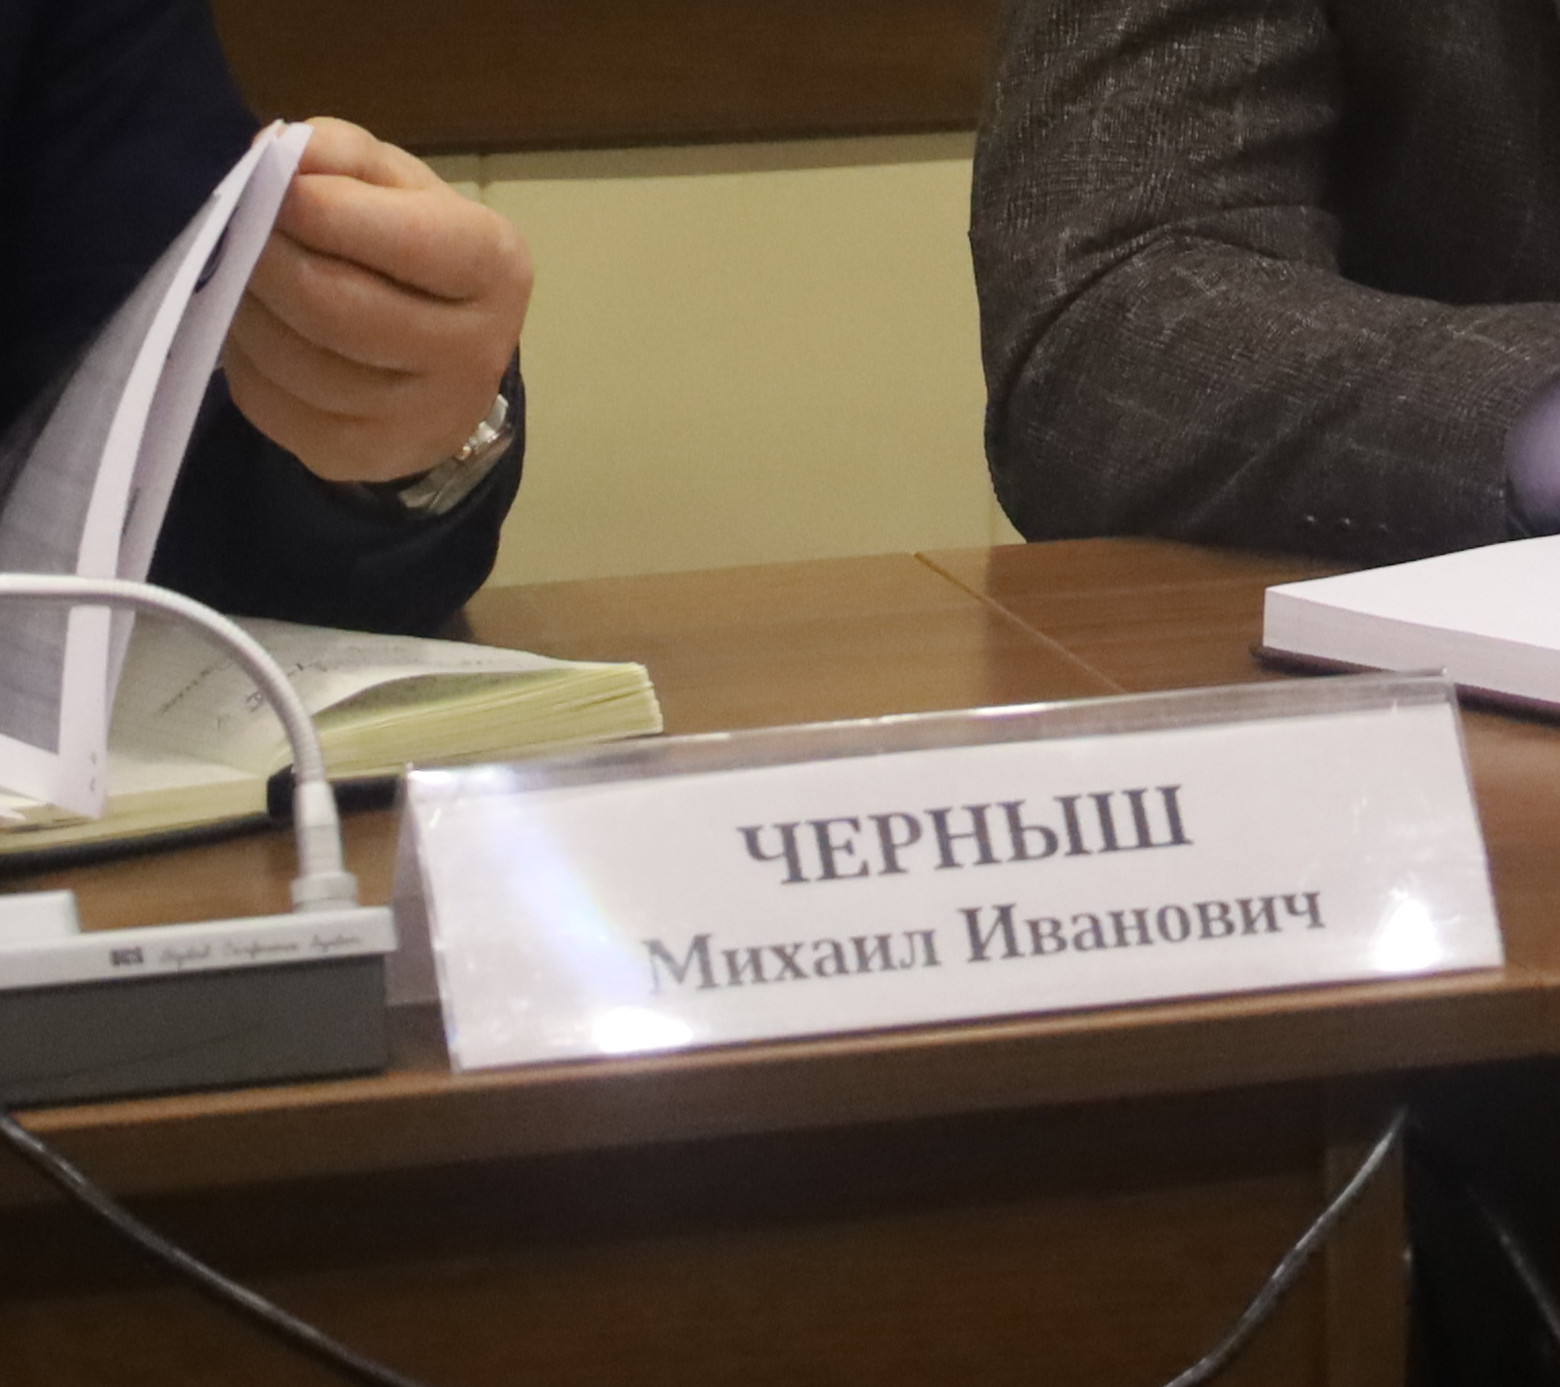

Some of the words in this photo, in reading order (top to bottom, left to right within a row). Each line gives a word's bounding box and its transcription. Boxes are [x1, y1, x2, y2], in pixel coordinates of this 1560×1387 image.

[735, 784, 1193, 884] ЧЕРНЫШ
[644, 925, 941, 994] Михаил
[957, 889, 1327, 965] Иванович
